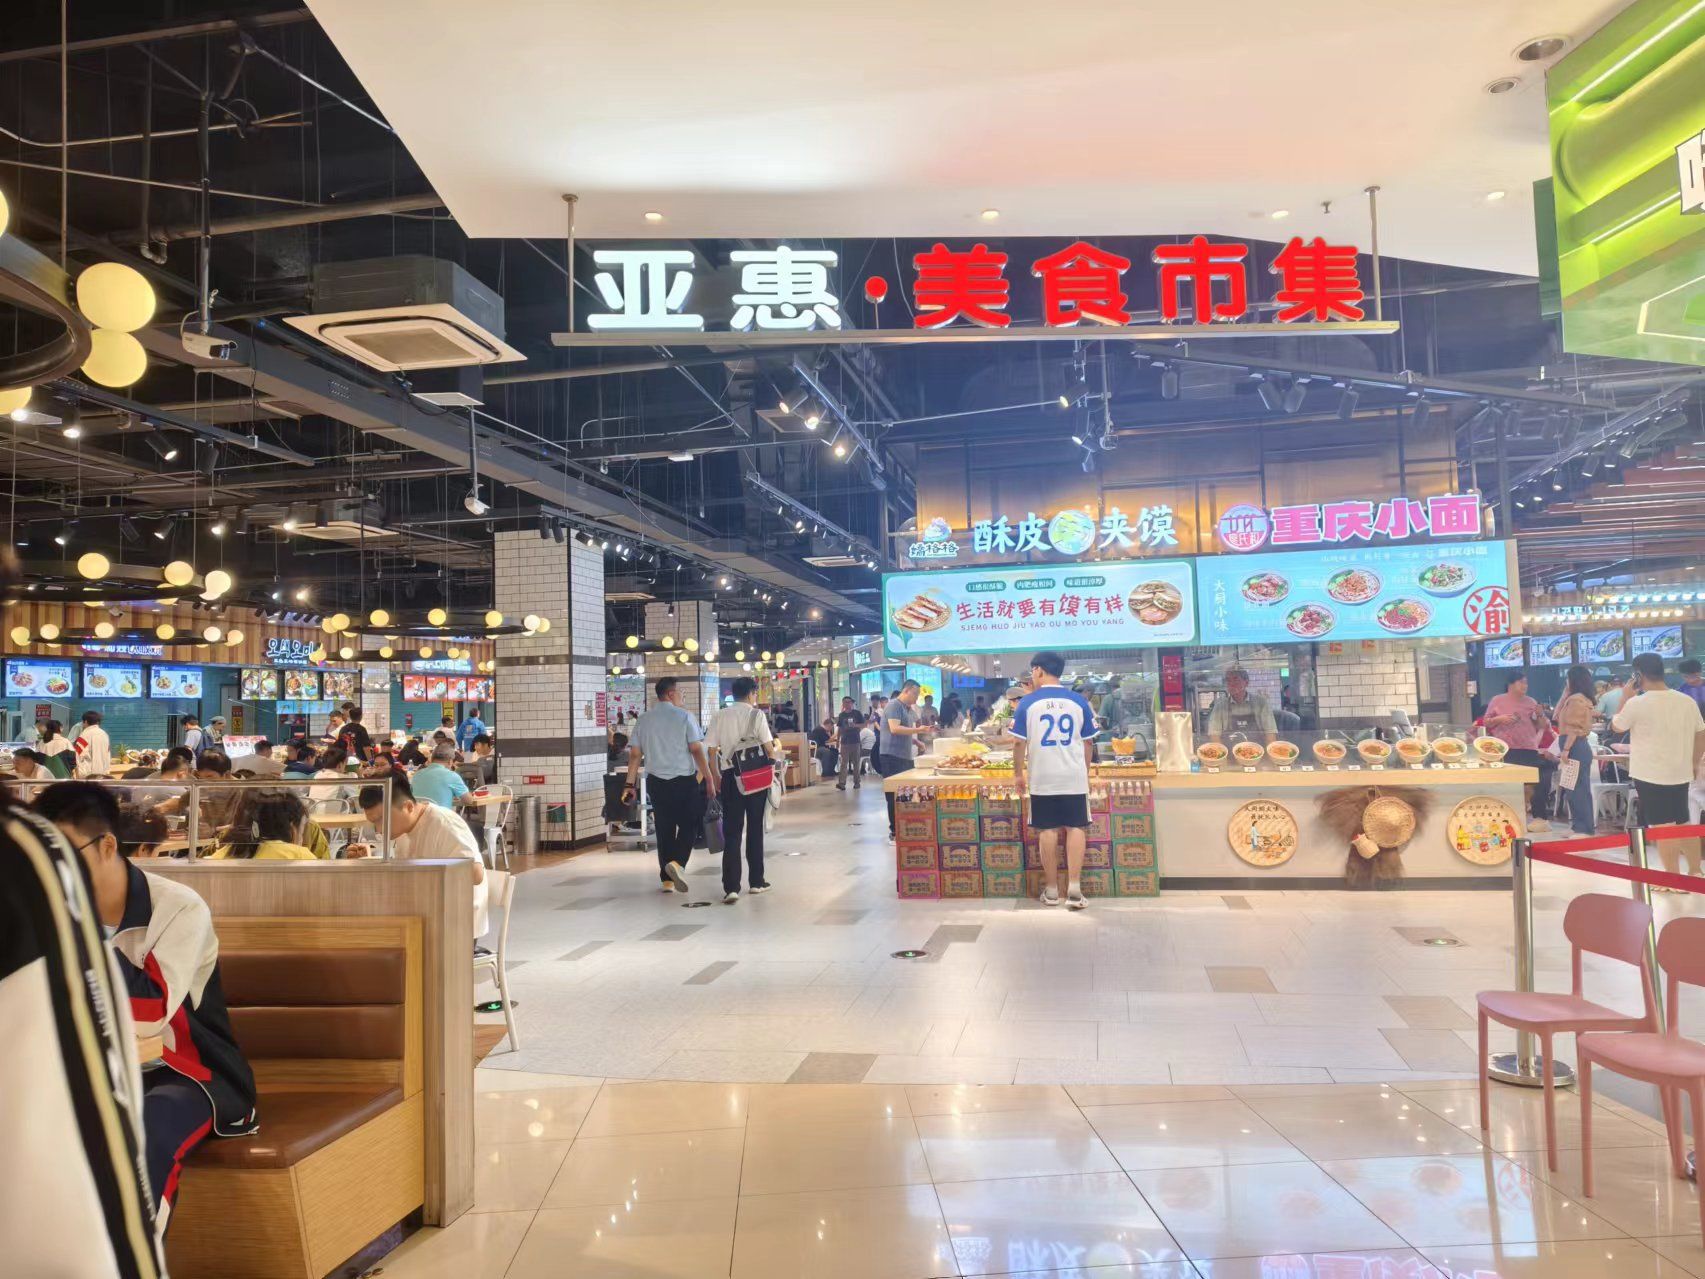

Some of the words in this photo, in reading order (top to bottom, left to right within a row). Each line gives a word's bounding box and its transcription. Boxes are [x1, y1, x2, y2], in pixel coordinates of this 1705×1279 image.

[973, 512, 1051, 553] 酥皮
[1099, 505, 1179, 549] 夹馍
[1271, 494, 1480, 544] 重庆小面
[956, 594, 1125, 620] 生活就要有馍有样
[1039, 713, 1074, 747] 29
